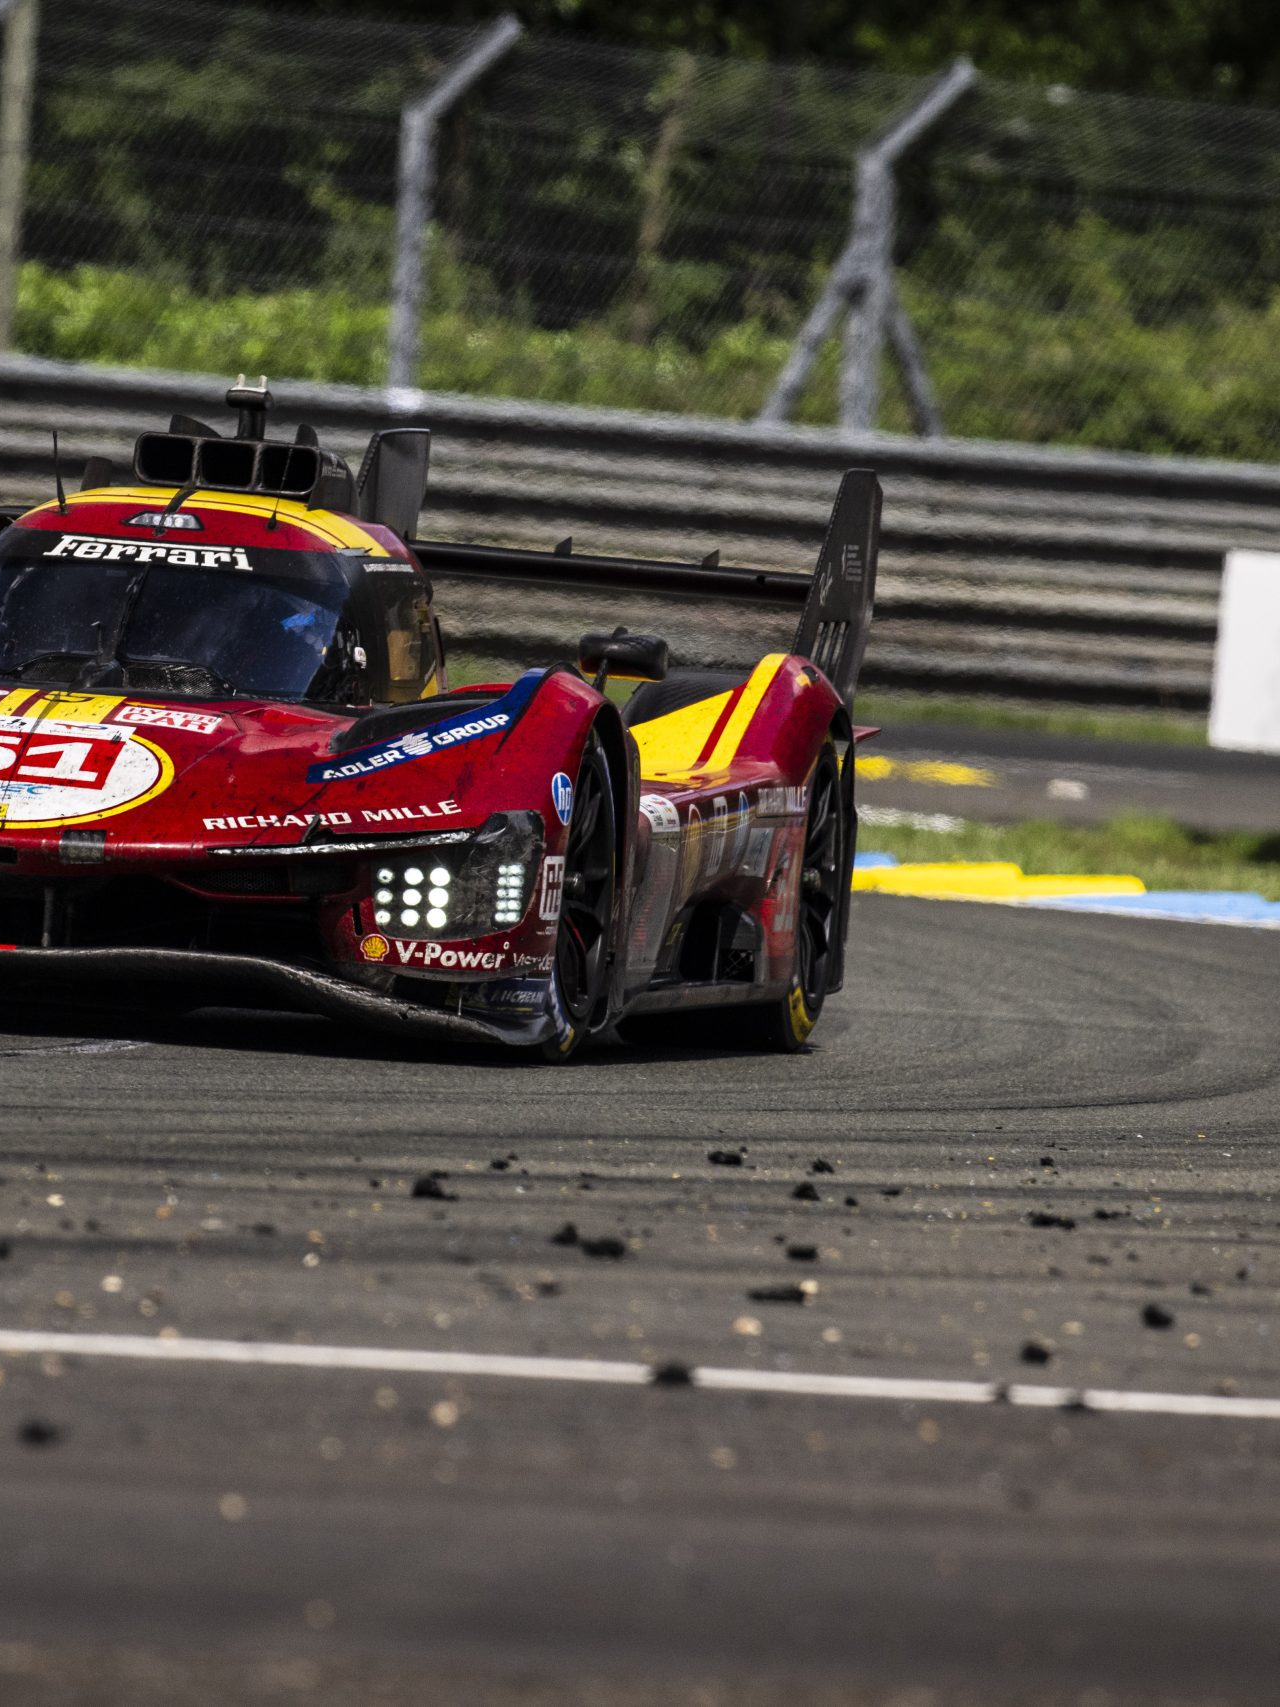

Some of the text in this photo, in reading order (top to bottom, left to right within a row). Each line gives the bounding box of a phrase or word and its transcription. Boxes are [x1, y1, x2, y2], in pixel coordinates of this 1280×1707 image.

[42, 534, 254, 571] Ferrari
[122, 712, 212, 732] CAR
[322, 713, 512, 780] ADLER GROUP
[557, 776, 573, 806] hp
[202, 799, 462, 831] RICHARD MILLE
[395, 941, 505, 971] V-Power
